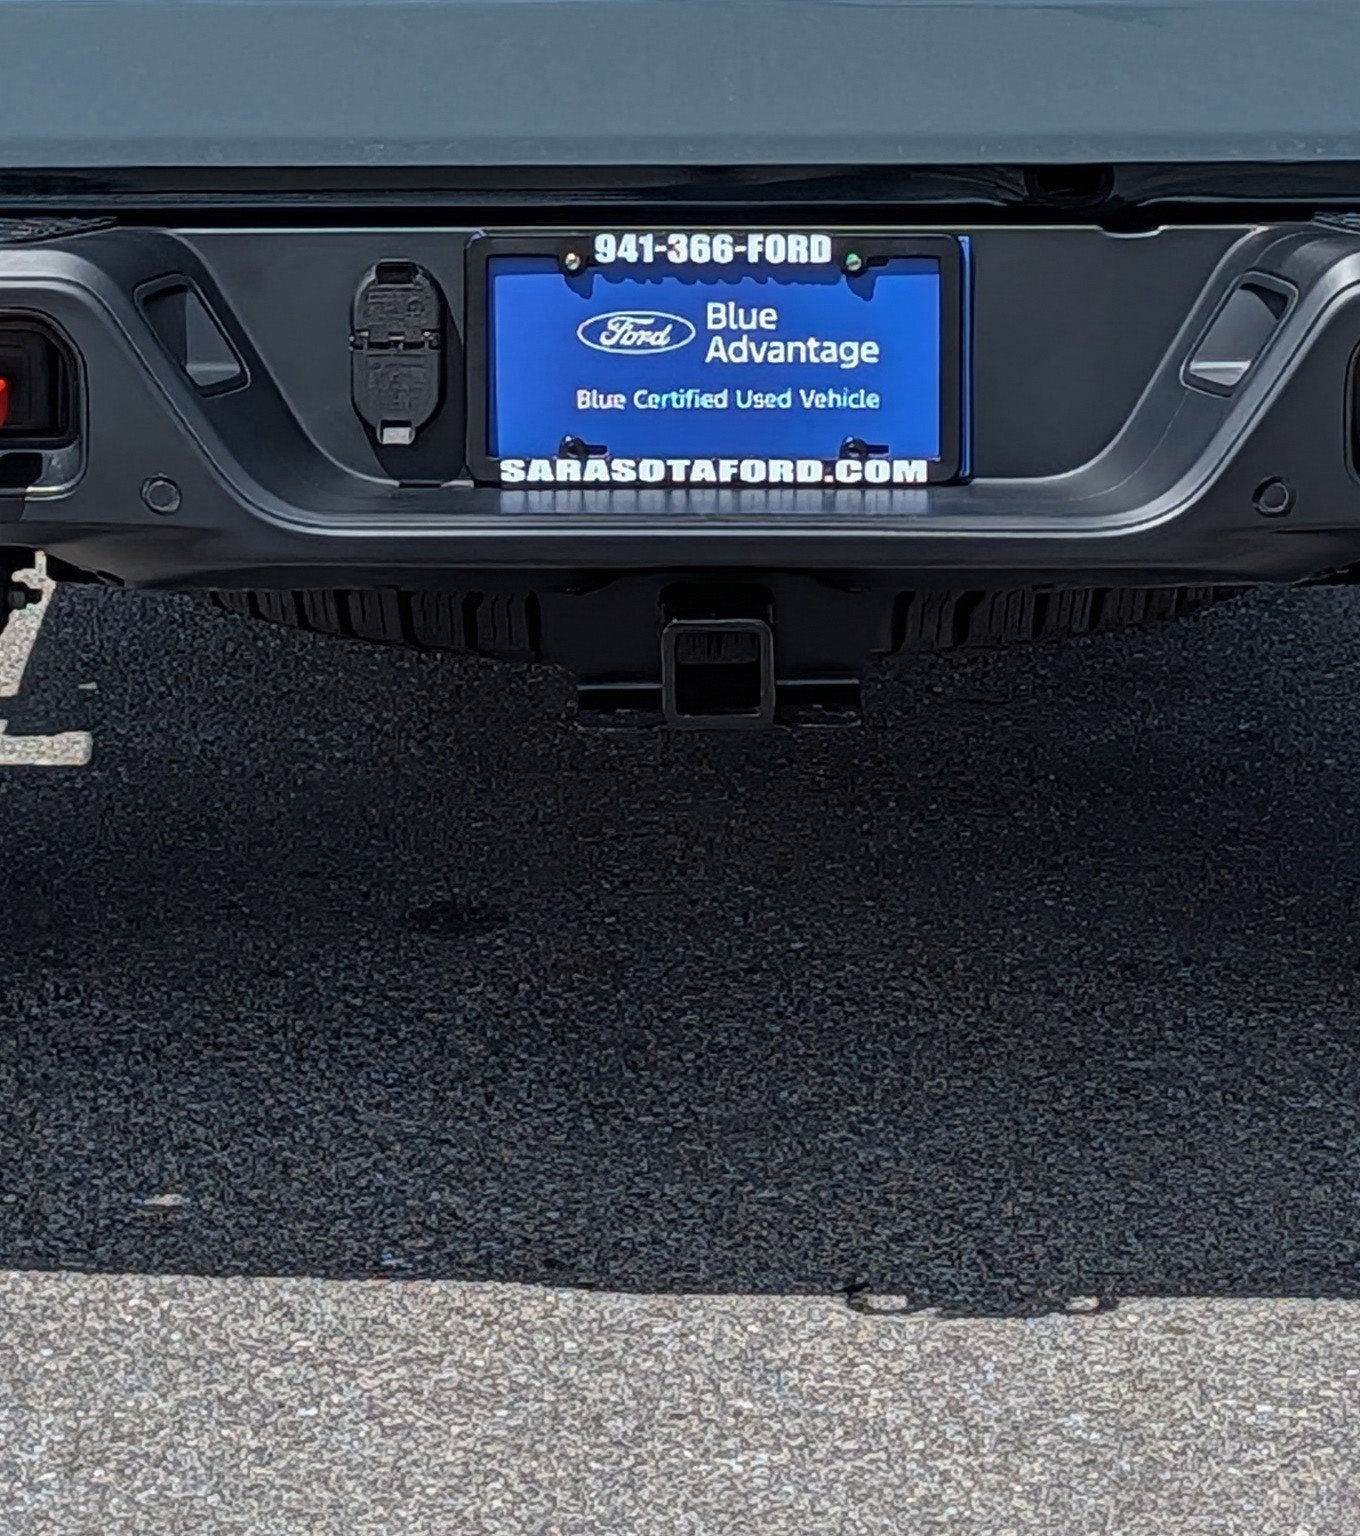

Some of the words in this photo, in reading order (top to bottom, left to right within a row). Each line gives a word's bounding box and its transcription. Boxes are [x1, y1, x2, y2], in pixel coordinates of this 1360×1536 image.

[594, 233, 833, 265] 941-366-FORD
[706, 301, 780, 331] Blue
[599, 316, 674, 348] Ford
[704, 335, 881, 369] Advantage
[576, 388, 627, 411] Blue
[633, 388, 729, 411] Certified
[736, 388, 793, 411] Used
[799, 387, 881, 411] Vehicle
[499, 459, 929, 484] SARASOTAFORD.COM
